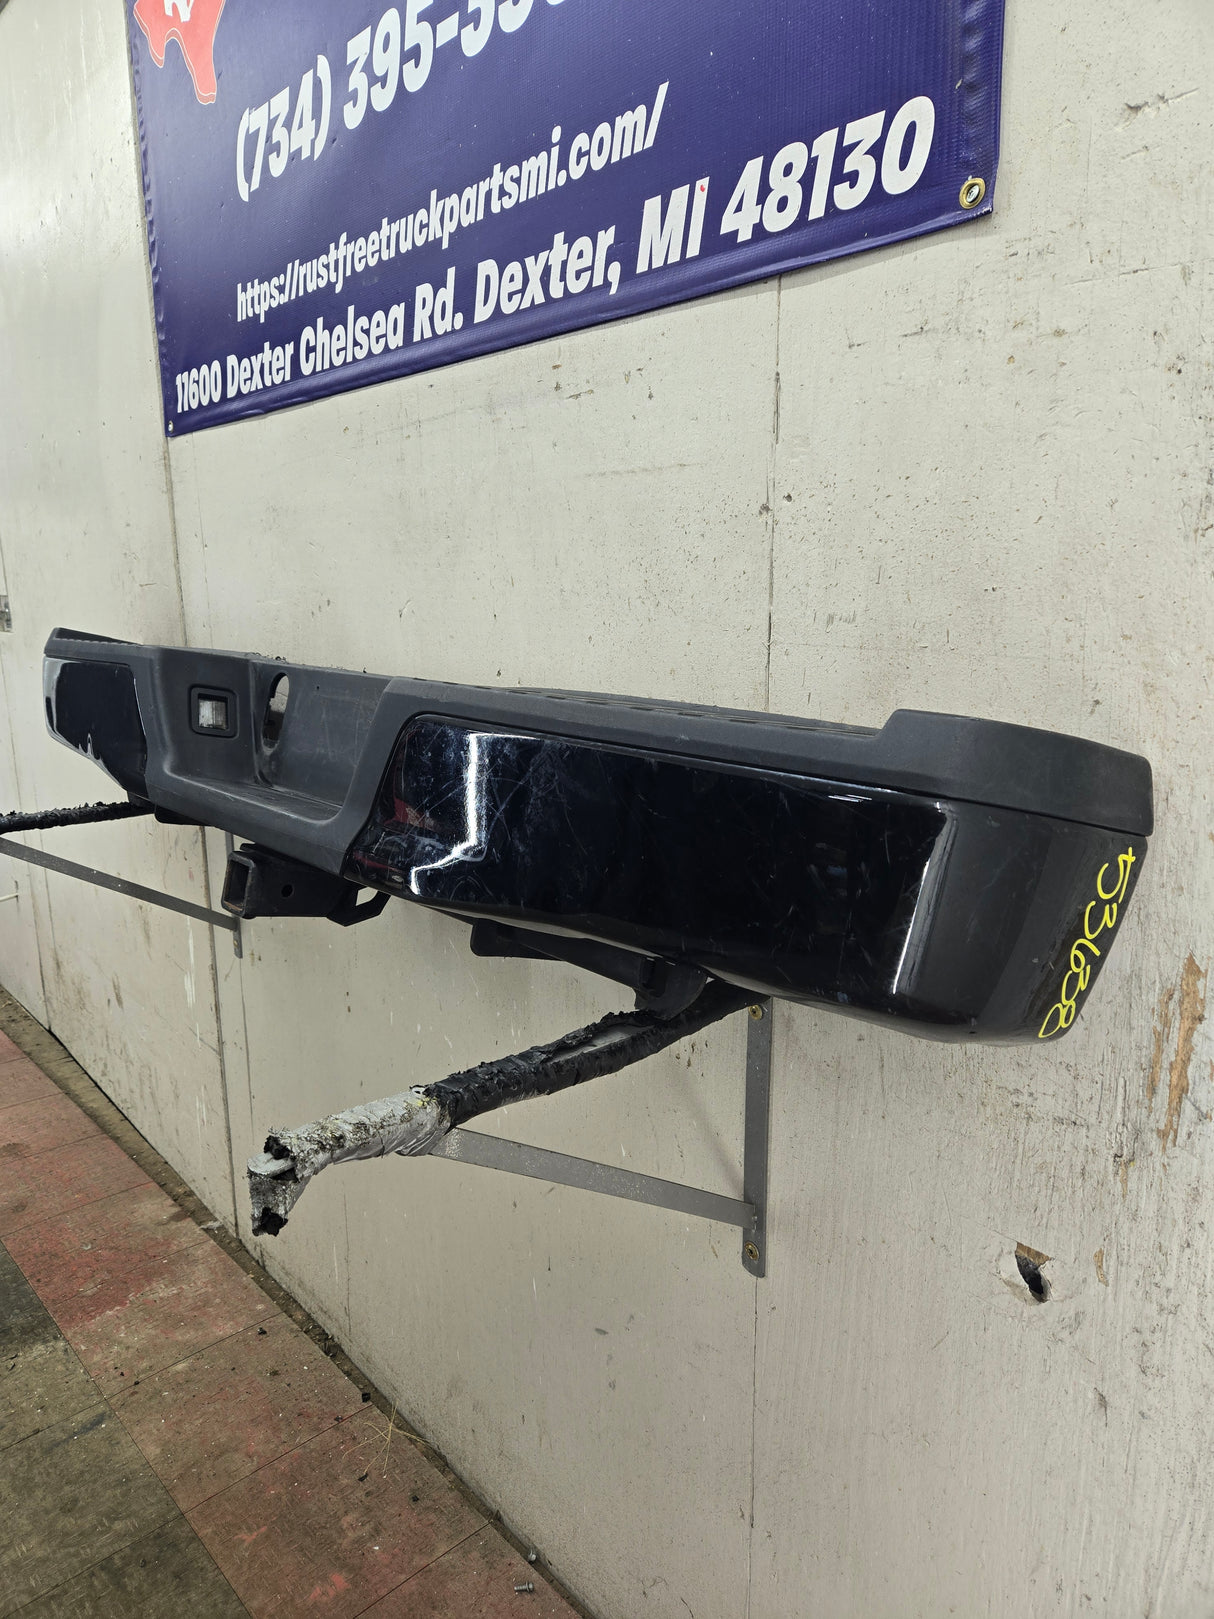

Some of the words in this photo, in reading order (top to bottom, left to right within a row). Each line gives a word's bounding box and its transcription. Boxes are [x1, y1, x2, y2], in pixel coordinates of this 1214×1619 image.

[237, 55, 332, 202] (734)
[344, 0, 565, 130] 395-
[237, 81, 669, 323] https://rustfreetruckpartsmi.com/
[176, 359, 222, 413] 11600
[227, 341, 294, 399] Dexter
[300, 305, 405, 376] Chelsea
[413, 267, 463, 343] Rd.
[473, 225, 621, 325] Dexter,
[636, 177, 710, 274] MI
[720, 95, 936, 244] 48130
